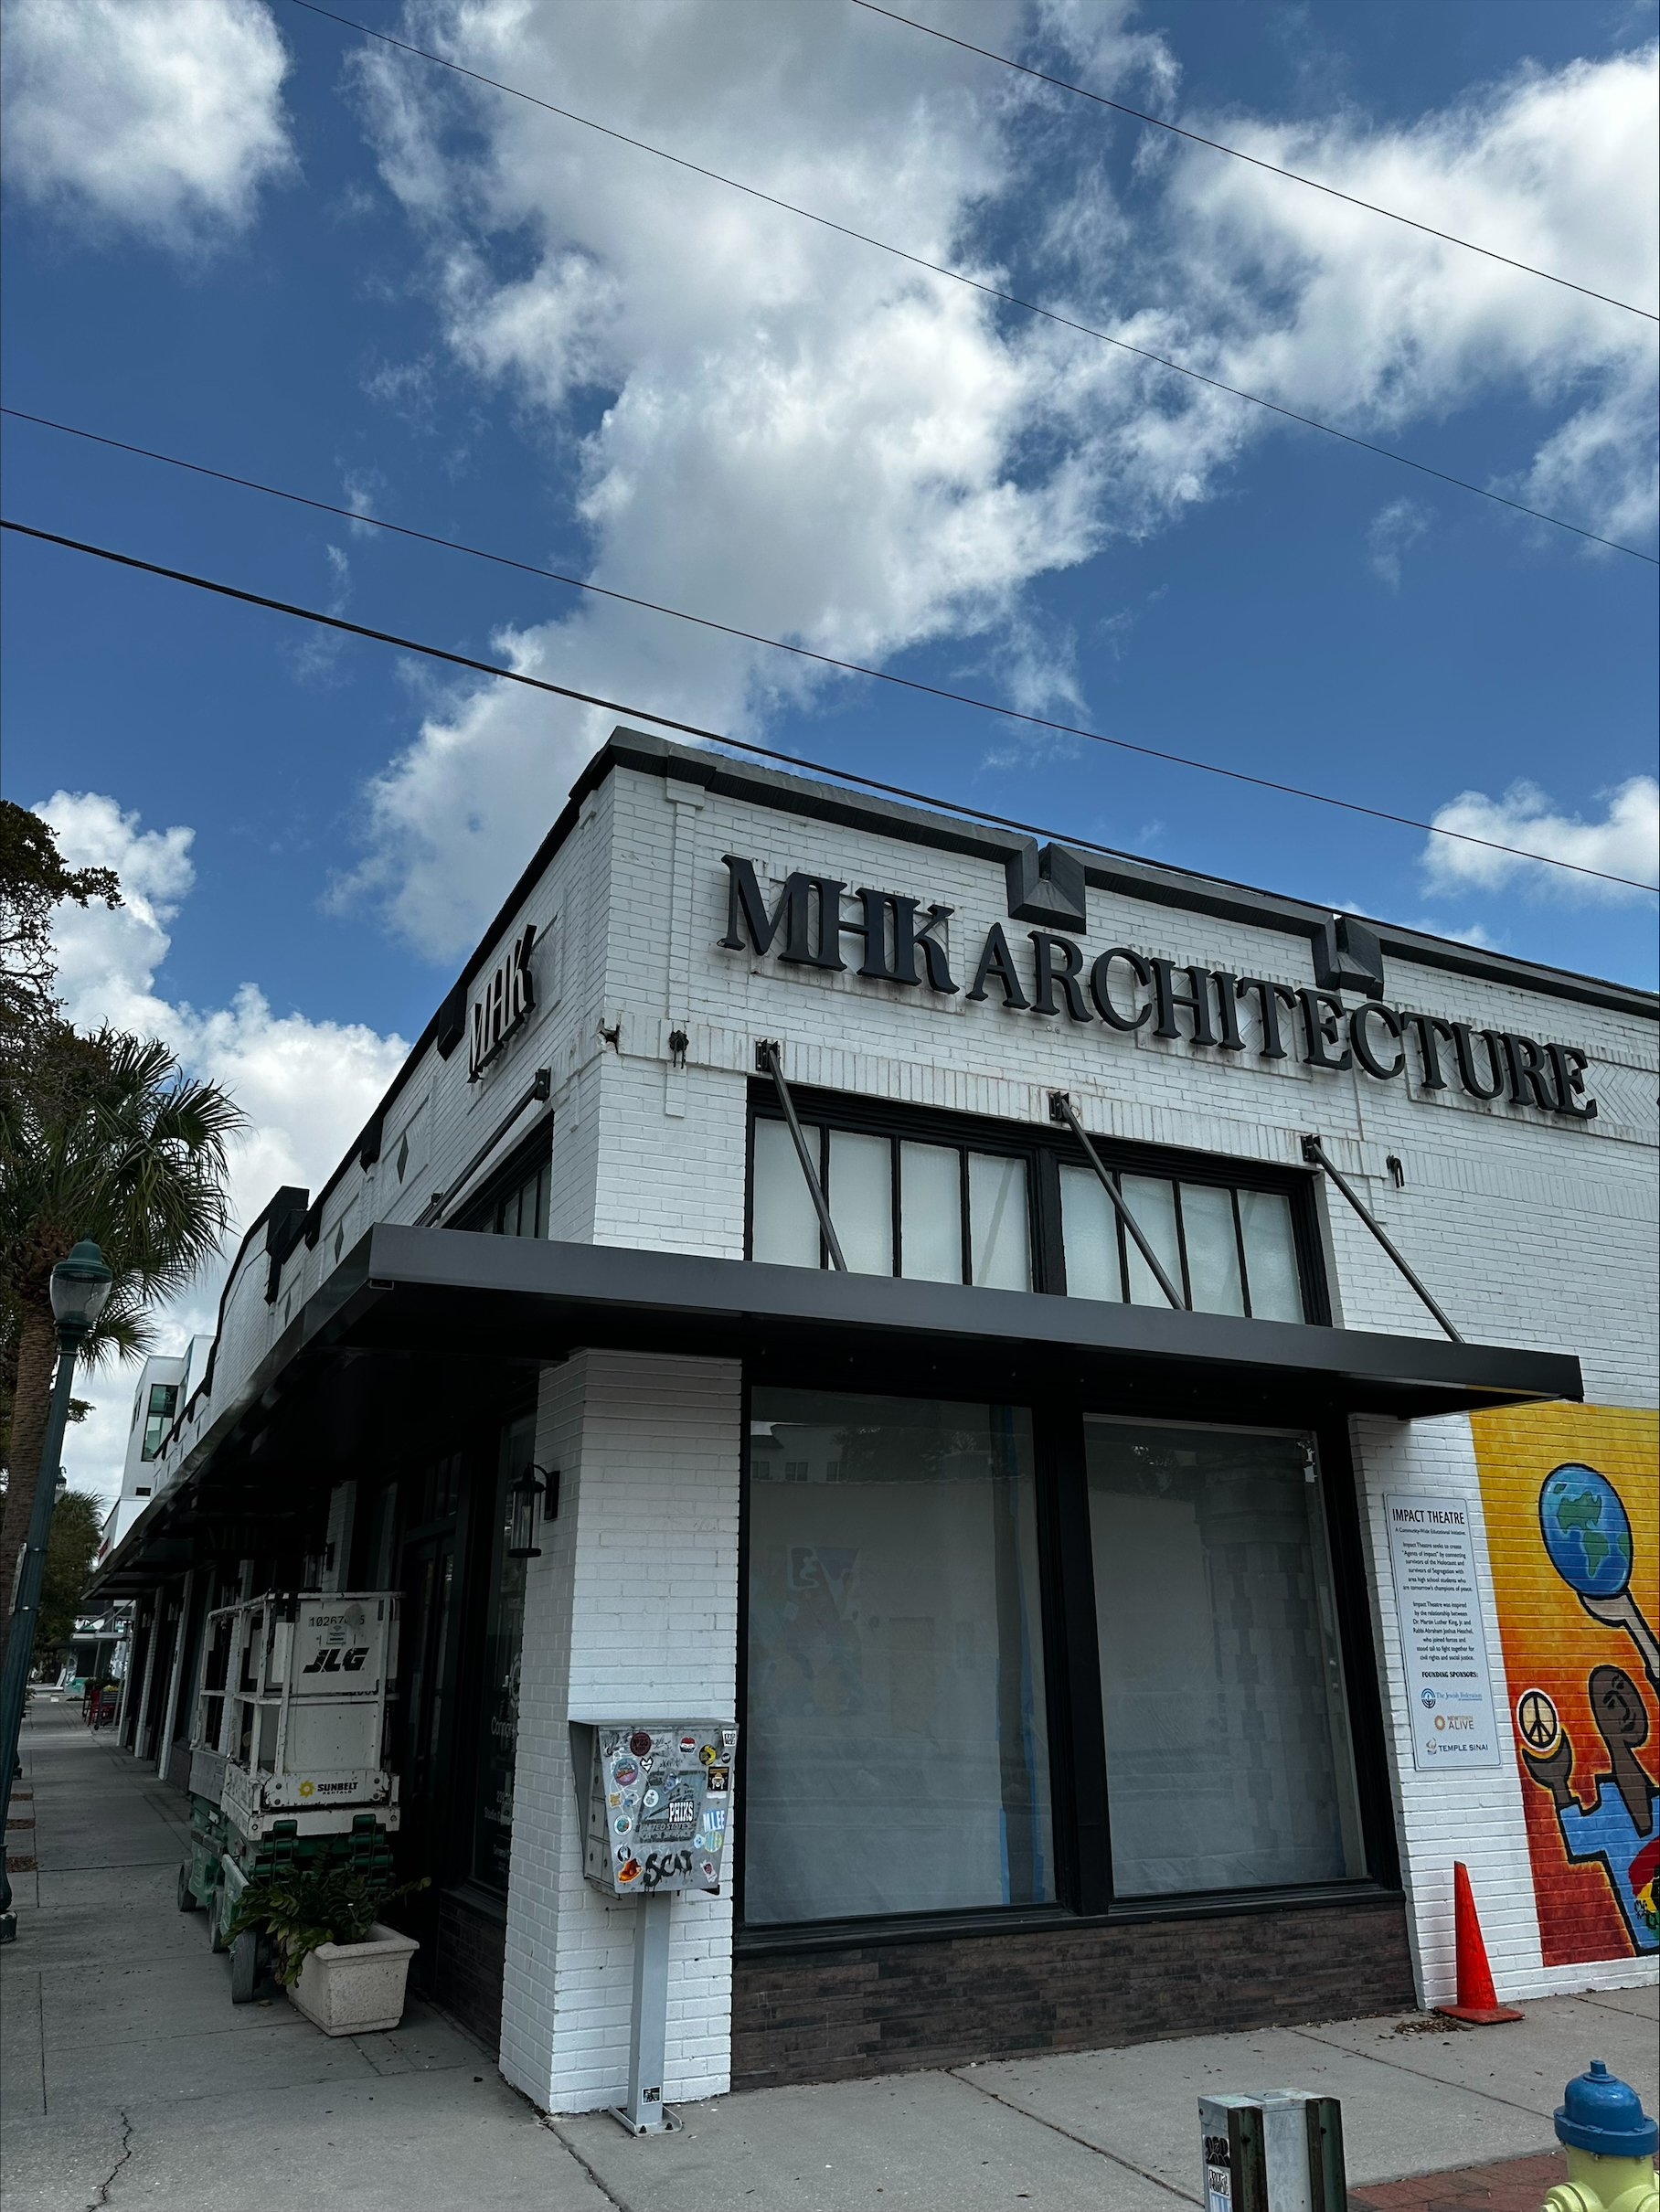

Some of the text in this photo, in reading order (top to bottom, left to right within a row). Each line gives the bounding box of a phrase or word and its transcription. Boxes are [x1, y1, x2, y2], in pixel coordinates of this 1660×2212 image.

[717, 854, 1598, 1121] MHK ARCHITECTURE
[467, 923, 537, 1082] MHK
[1392, 1508, 1464, 1525] IMPACT THEATRE
[303, 1647, 370, 1674] JLG
[1449, 1720, 1474, 1730] ALIVE
[1438, 1744, 1467, 1752] TEMPLE
[317, 1781, 358, 1792] SUNBELT
[669, 1802, 693, 1823] PHIKS
